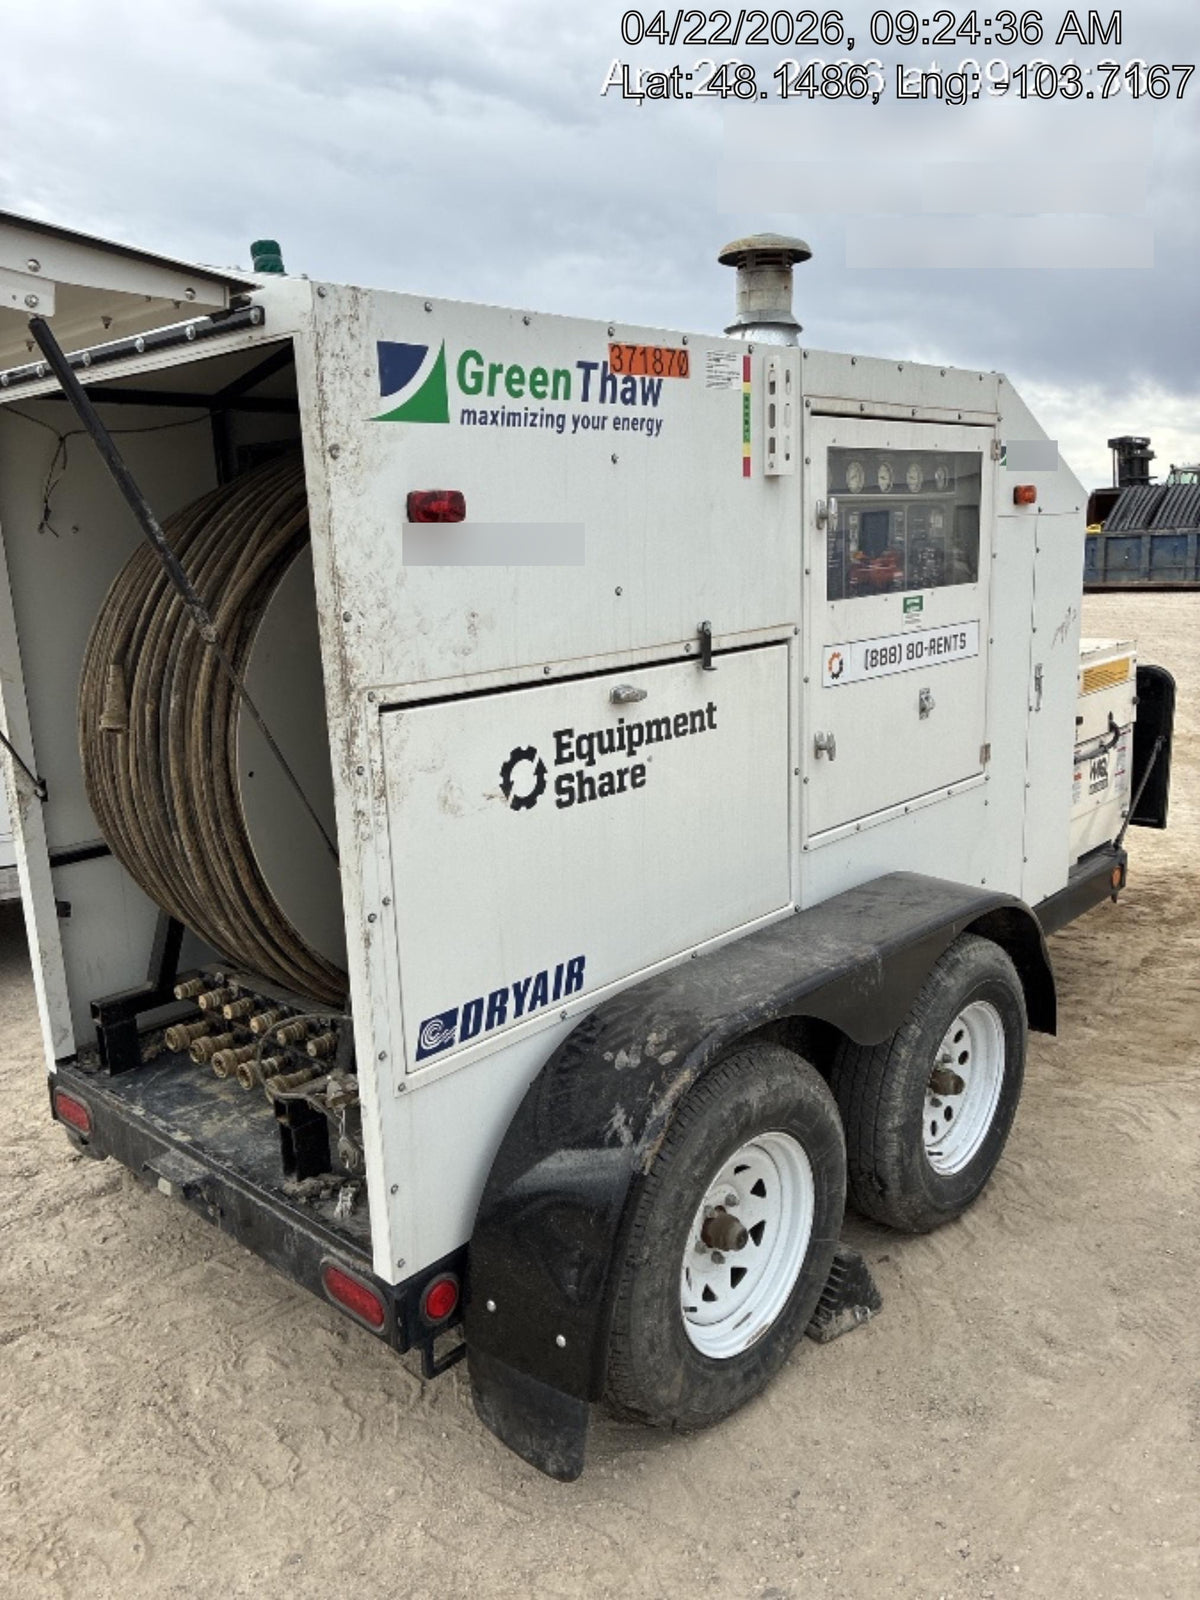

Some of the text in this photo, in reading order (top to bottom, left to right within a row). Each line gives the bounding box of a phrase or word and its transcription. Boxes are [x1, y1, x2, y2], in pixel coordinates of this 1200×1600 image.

[457, 348, 664, 407] GreenThaw
[610, 344, 689, 376] 371870
[459, 405, 664, 437] maximizing your energy
[864, 632, 967, 670] (888) 80-RENTS
[553, 702, 718, 766] Equipment
[554, 761, 646, 809] Share
[458, 954, 586, 1044] DRYAIR
